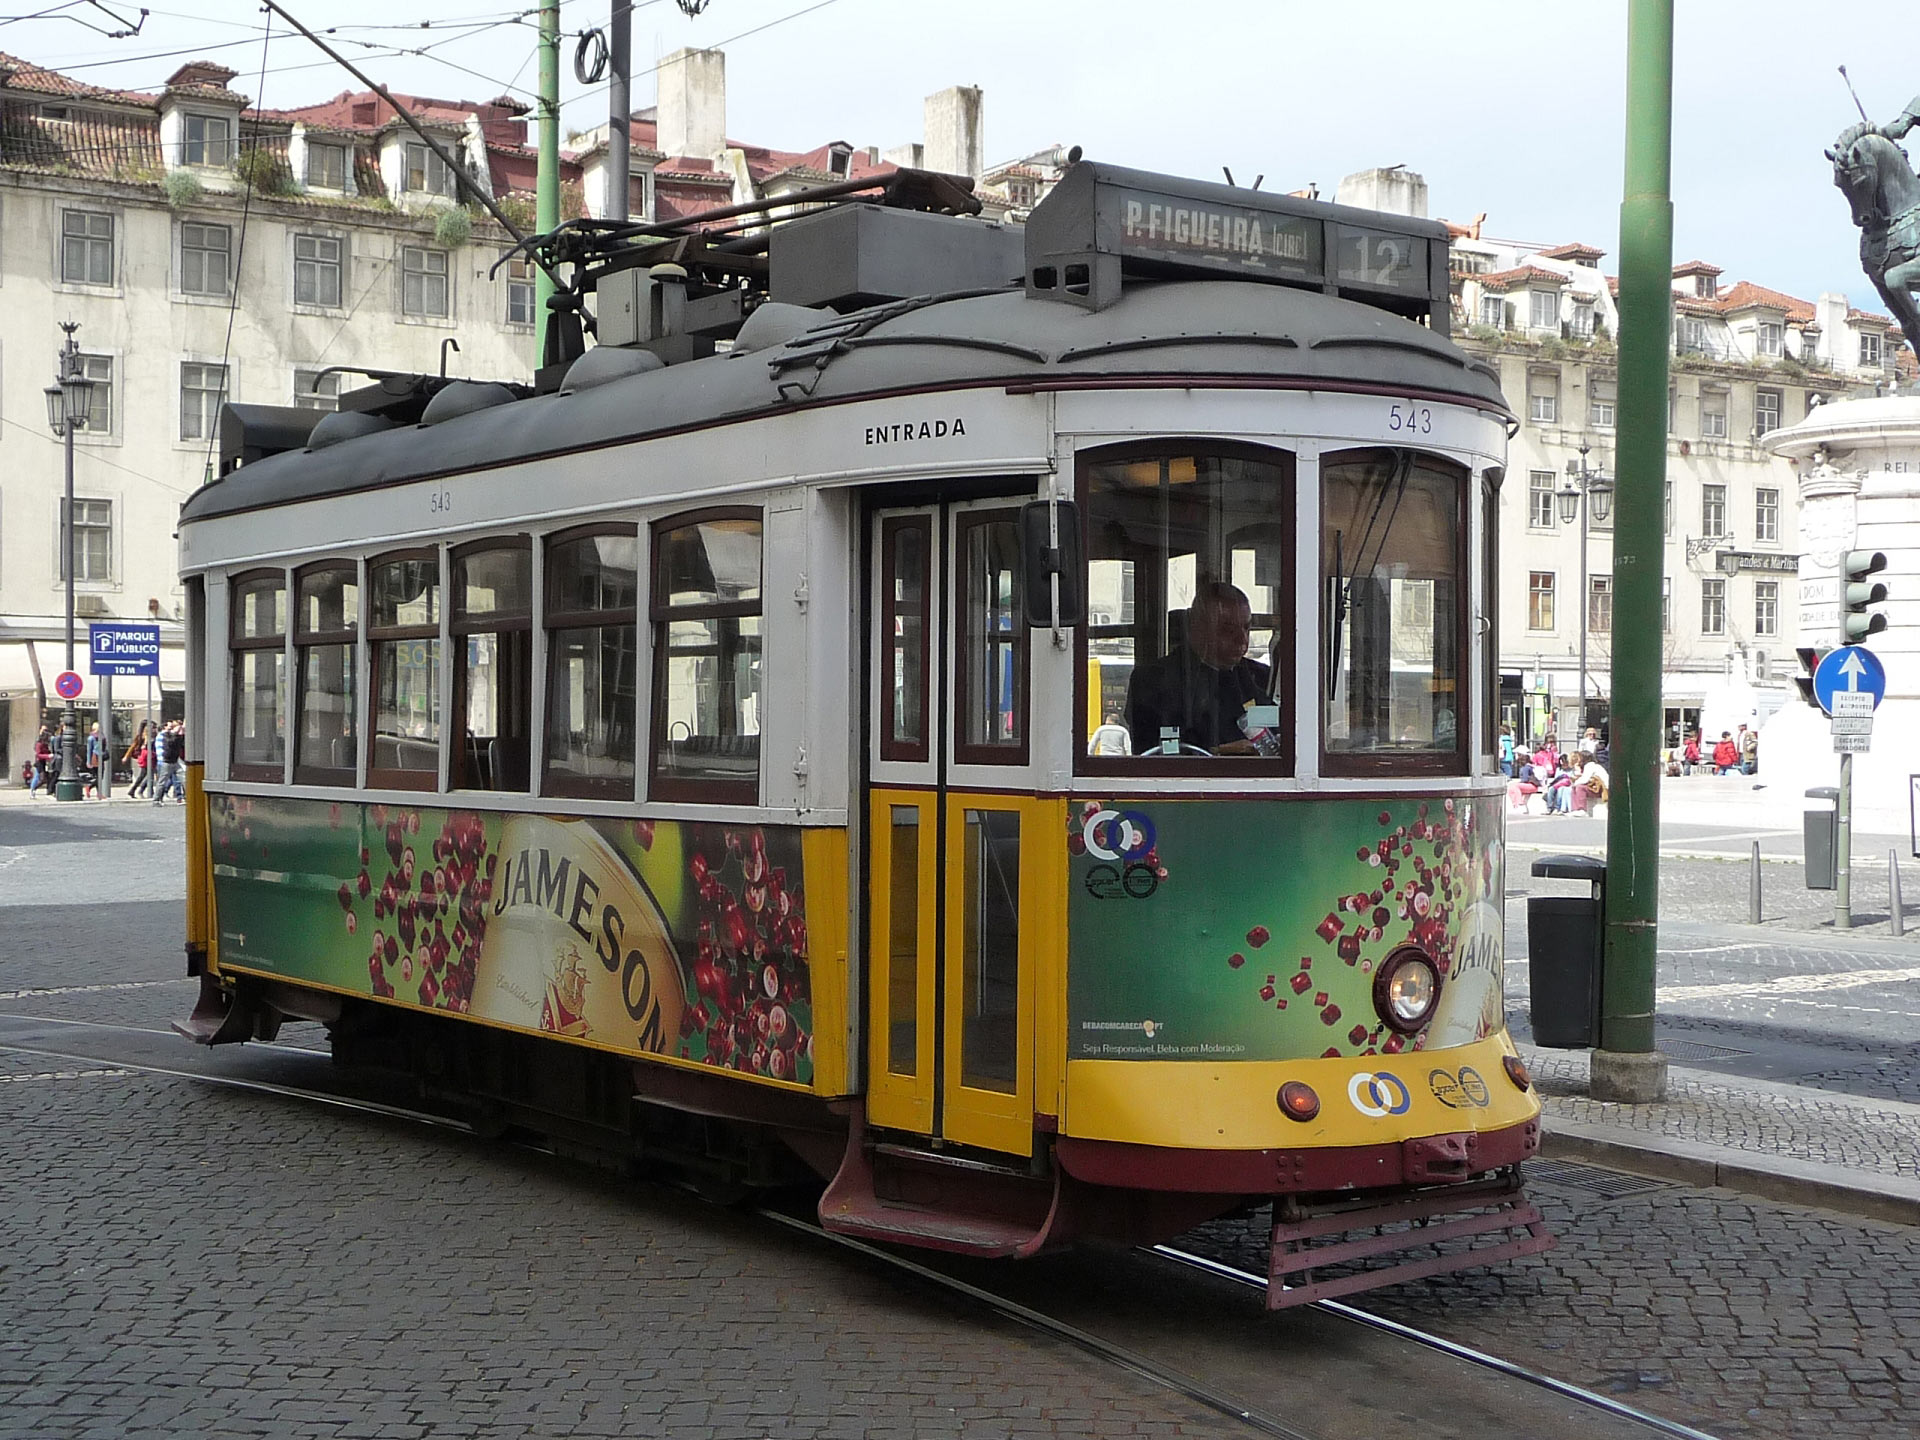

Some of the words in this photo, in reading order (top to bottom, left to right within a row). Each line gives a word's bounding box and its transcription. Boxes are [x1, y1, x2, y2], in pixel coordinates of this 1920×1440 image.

[1354, 235, 1400, 287] 12
[1389, 405, 1431, 433] 543
[865, 418, 966, 445] ENTRADA
[1884, 461, 1907, 474] REI
[431, 491, 450, 513] 543
[115, 631, 156, 642] PARQUE
[115, 642, 159, 654] PÚBLICO
[115, 666, 126, 675] 10
[126, 666, 136, 675] M
[495, 848, 667, 1053] JAMESON
[1083, 1043, 1101, 1055] Seja
[1157, 1043, 1179, 1053] Beba
[1180, 1045, 1199, 1053] com
